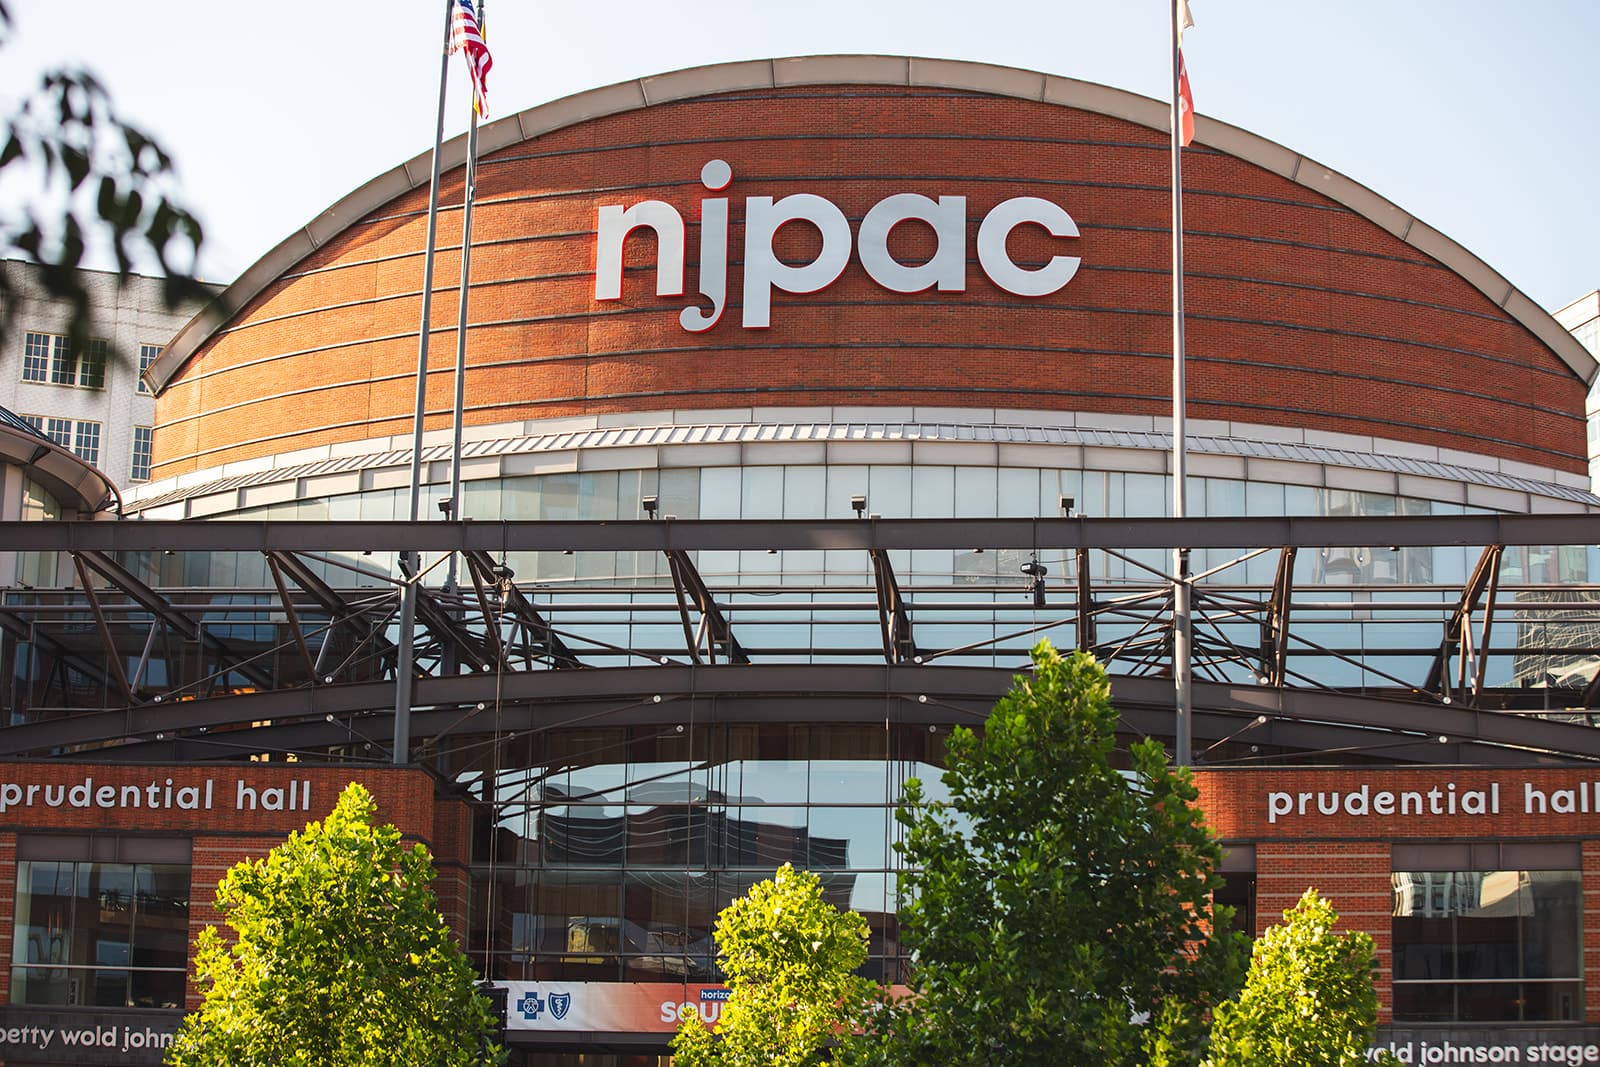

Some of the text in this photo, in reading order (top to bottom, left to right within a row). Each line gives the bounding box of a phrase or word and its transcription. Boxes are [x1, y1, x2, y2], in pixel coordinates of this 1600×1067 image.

[594, 158, 1082, 333] njpac
[0, 777, 310, 813] prudential hall
[1268, 781, 1600, 824] prudential hall
[701, 990, 731, 1000] horizo
[660, 1001, 725, 1024] SOU
[60, 1025, 117, 1047] wold
[121, 1026, 184, 1053] john
[1418, 1040, 1519, 1067] johnson
[1526, 1041, 1600, 1067] stage
